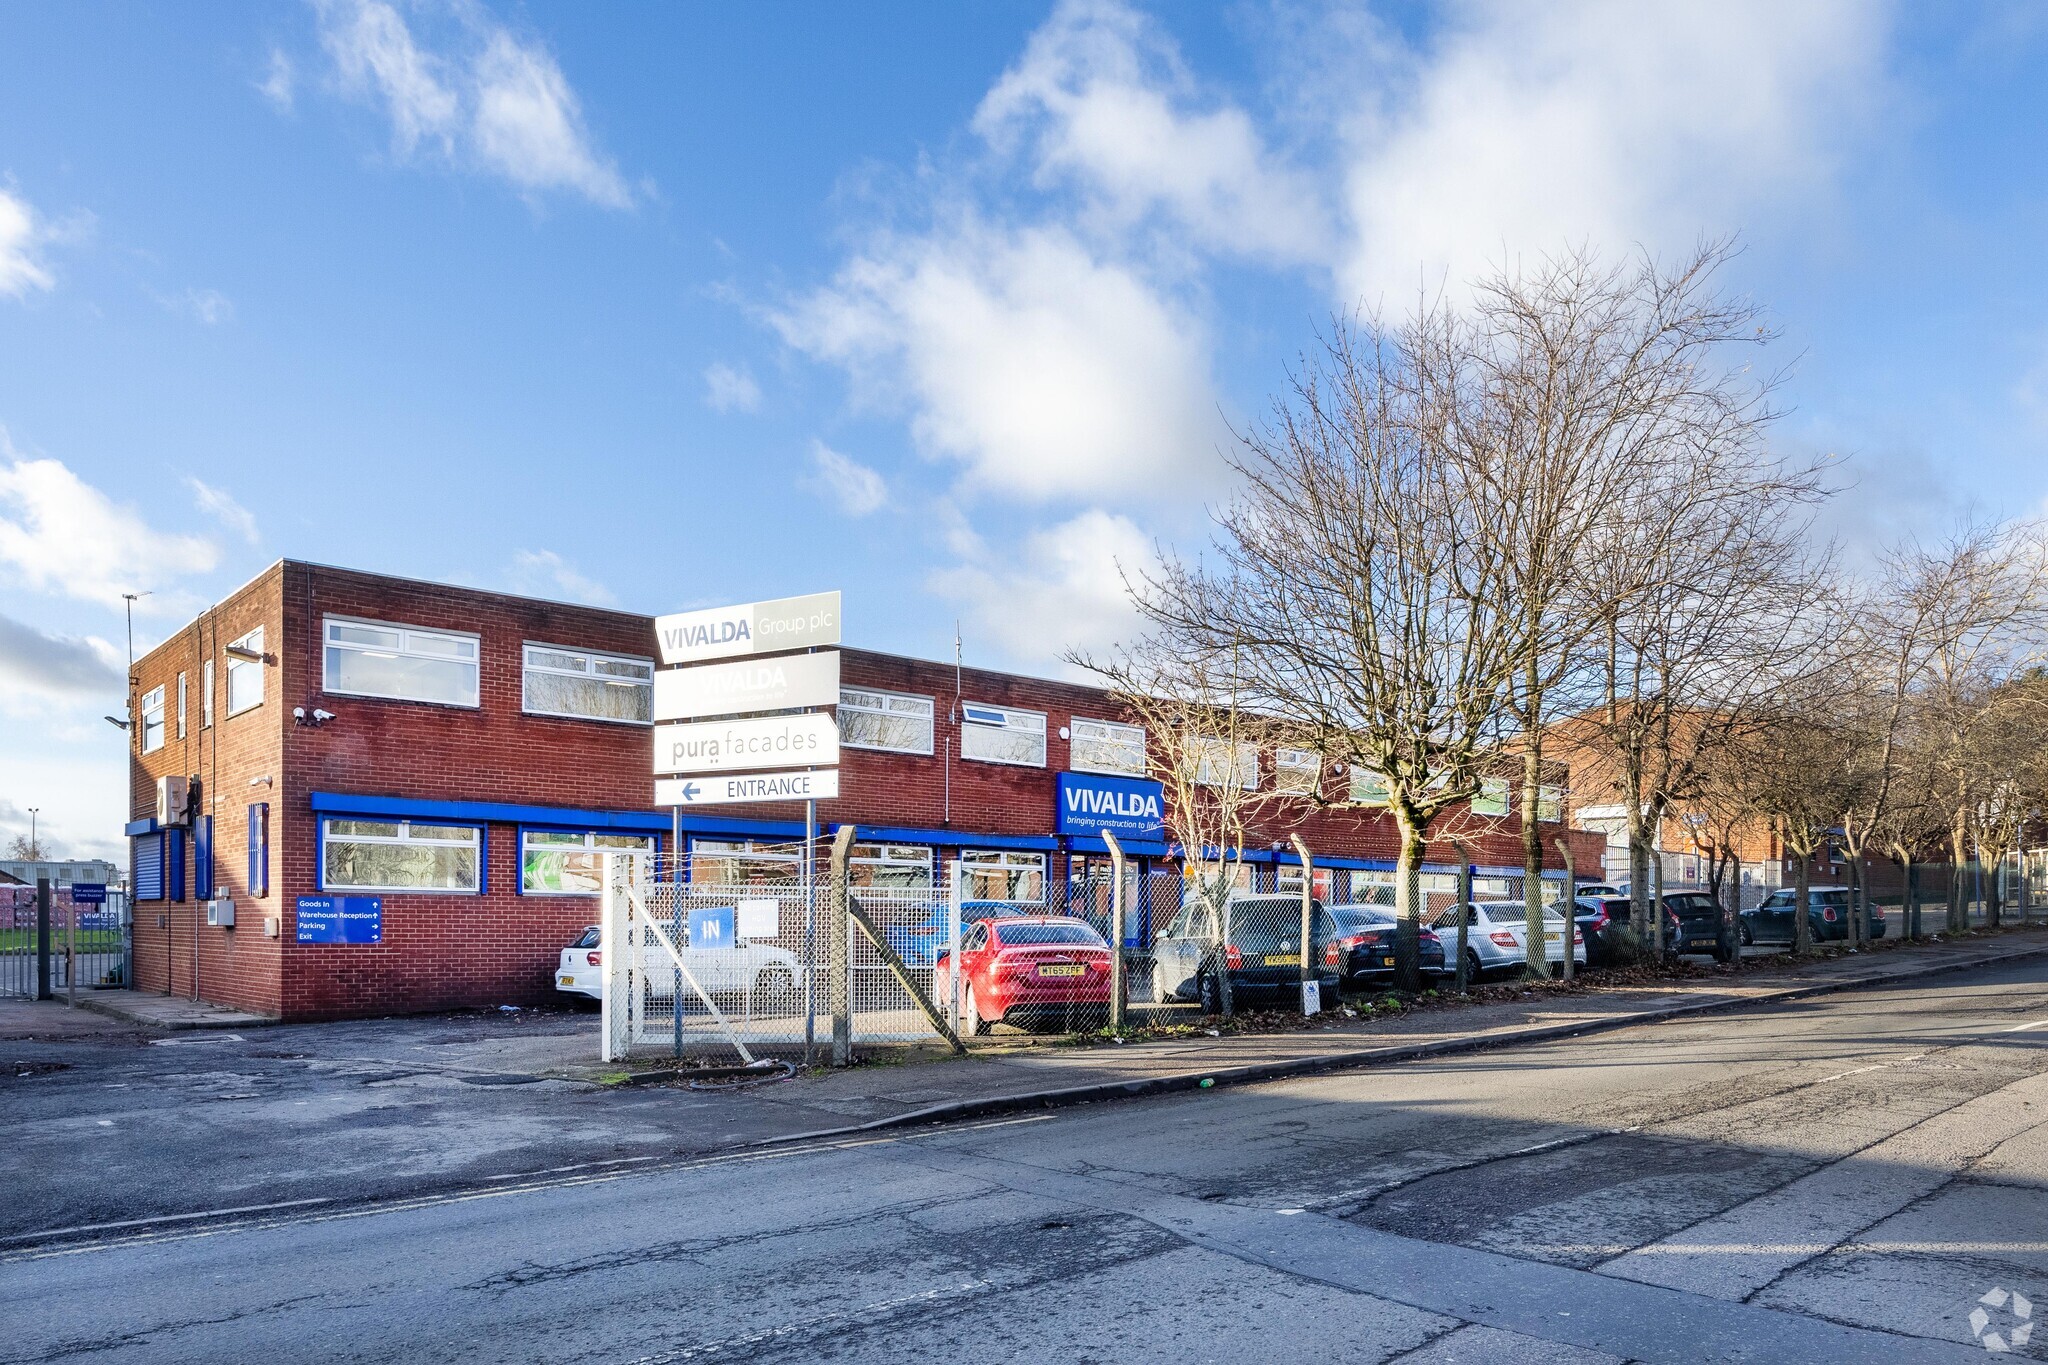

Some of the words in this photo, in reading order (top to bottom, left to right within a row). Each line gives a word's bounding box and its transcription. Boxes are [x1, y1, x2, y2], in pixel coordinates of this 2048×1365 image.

[665, 619, 750, 649] VIVALDA
[758, 615, 805, 635] Group
[810, 610, 832, 632] plc
[701, 665, 788, 695] VIVALDA
[725, 726, 817, 754] facades
[728, 777, 810, 798] ENTRANCE
[1065, 787, 1160, 818] VIVALDA
[1066, 815, 1095, 828] bringing
[1097, 818, 1137, 829] construction
[1138, 821, 1145, 829] to
[299, 900, 322, 908] Goods
[299, 911, 338, 919] Warehouse
[339, 912, 373, 920] Reception
[299, 922, 326, 930] Parking
[702, 919, 720, 940] IN
